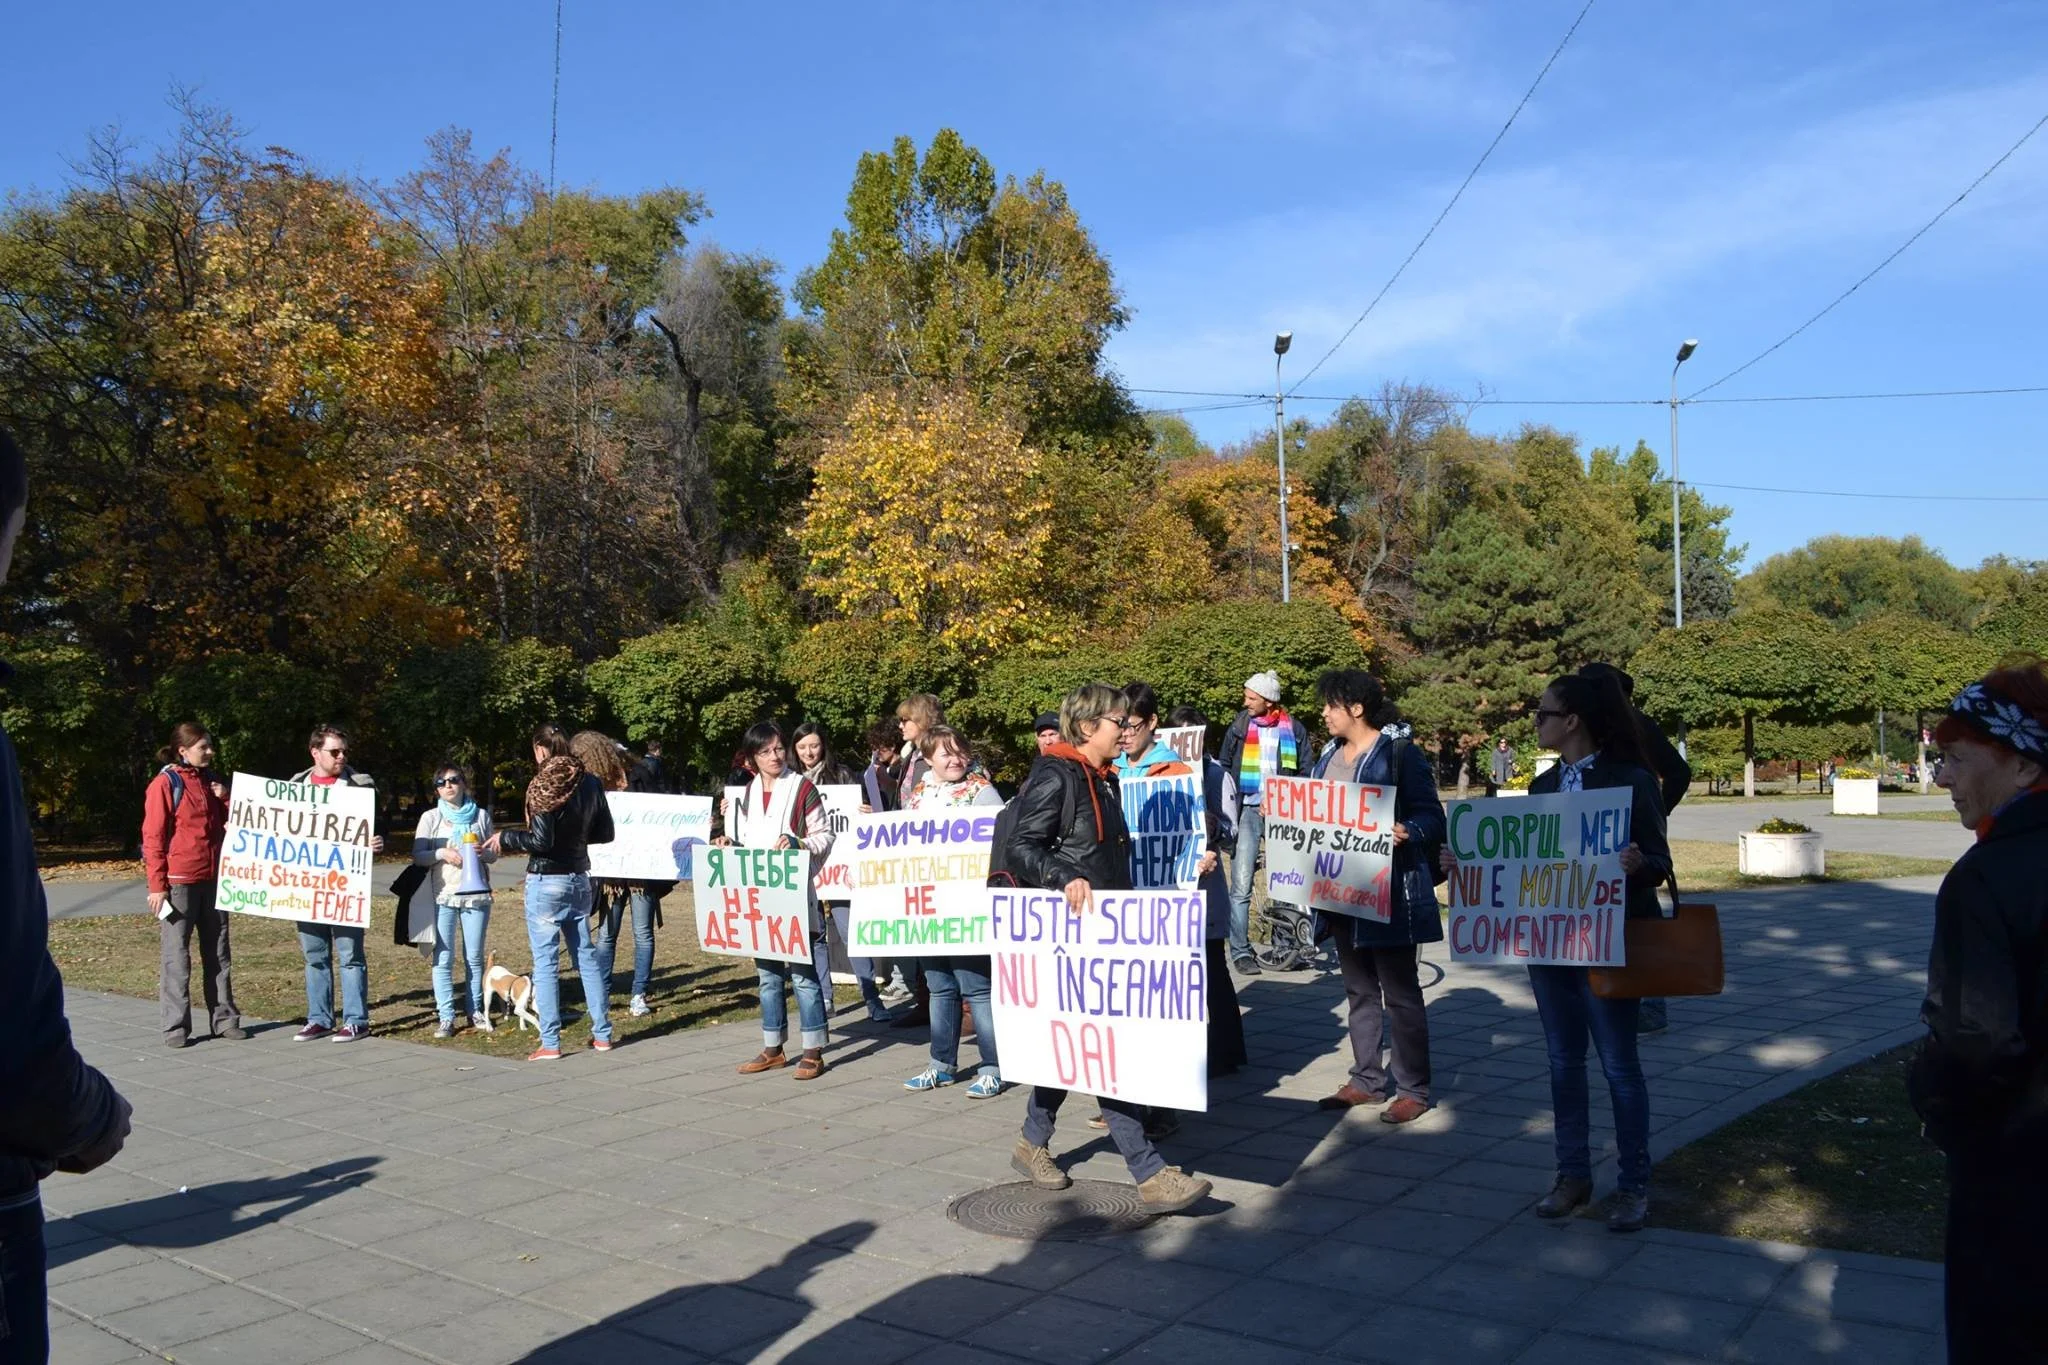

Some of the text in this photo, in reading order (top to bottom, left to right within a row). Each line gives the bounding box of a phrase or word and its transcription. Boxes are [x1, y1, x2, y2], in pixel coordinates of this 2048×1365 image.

[1170, 730, 1204, 762] MEU
[1266, 778, 1382, 833] FEMEILE
[857, 817, 998, 850] УЛИЧНОЕ
[1268, 823, 1306, 852] merg
[1307, 829, 1325, 853] pe
[1450, 803, 1630, 861] CORPUL MEU
[269, 864, 349, 891] Străzile
[707, 850, 727, 888] Я
[735, 849, 799, 890] ТЕБЕ
[1269, 868, 1305, 891] pentru
[1314, 851, 1344, 879] NU
[1449, 859, 1623, 909] NU E MOTIV DE
[219, 880, 365, 923] Sigure pentru FEMEI
[723, 887, 760, 914] НЕ
[905, 885, 936, 916] НЕ
[1098, 892, 1202, 948] SCURTĂ
[704, 911, 807, 957] ДЕТКА
[857, 916, 989, 946] КОМПЛИМЕНТ
[1452, 908, 1613, 961] COMENTARII
[998, 945, 1204, 1022] NU ÎNSEAMNĂ
[1050, 1020, 1118, 1095] DA!
